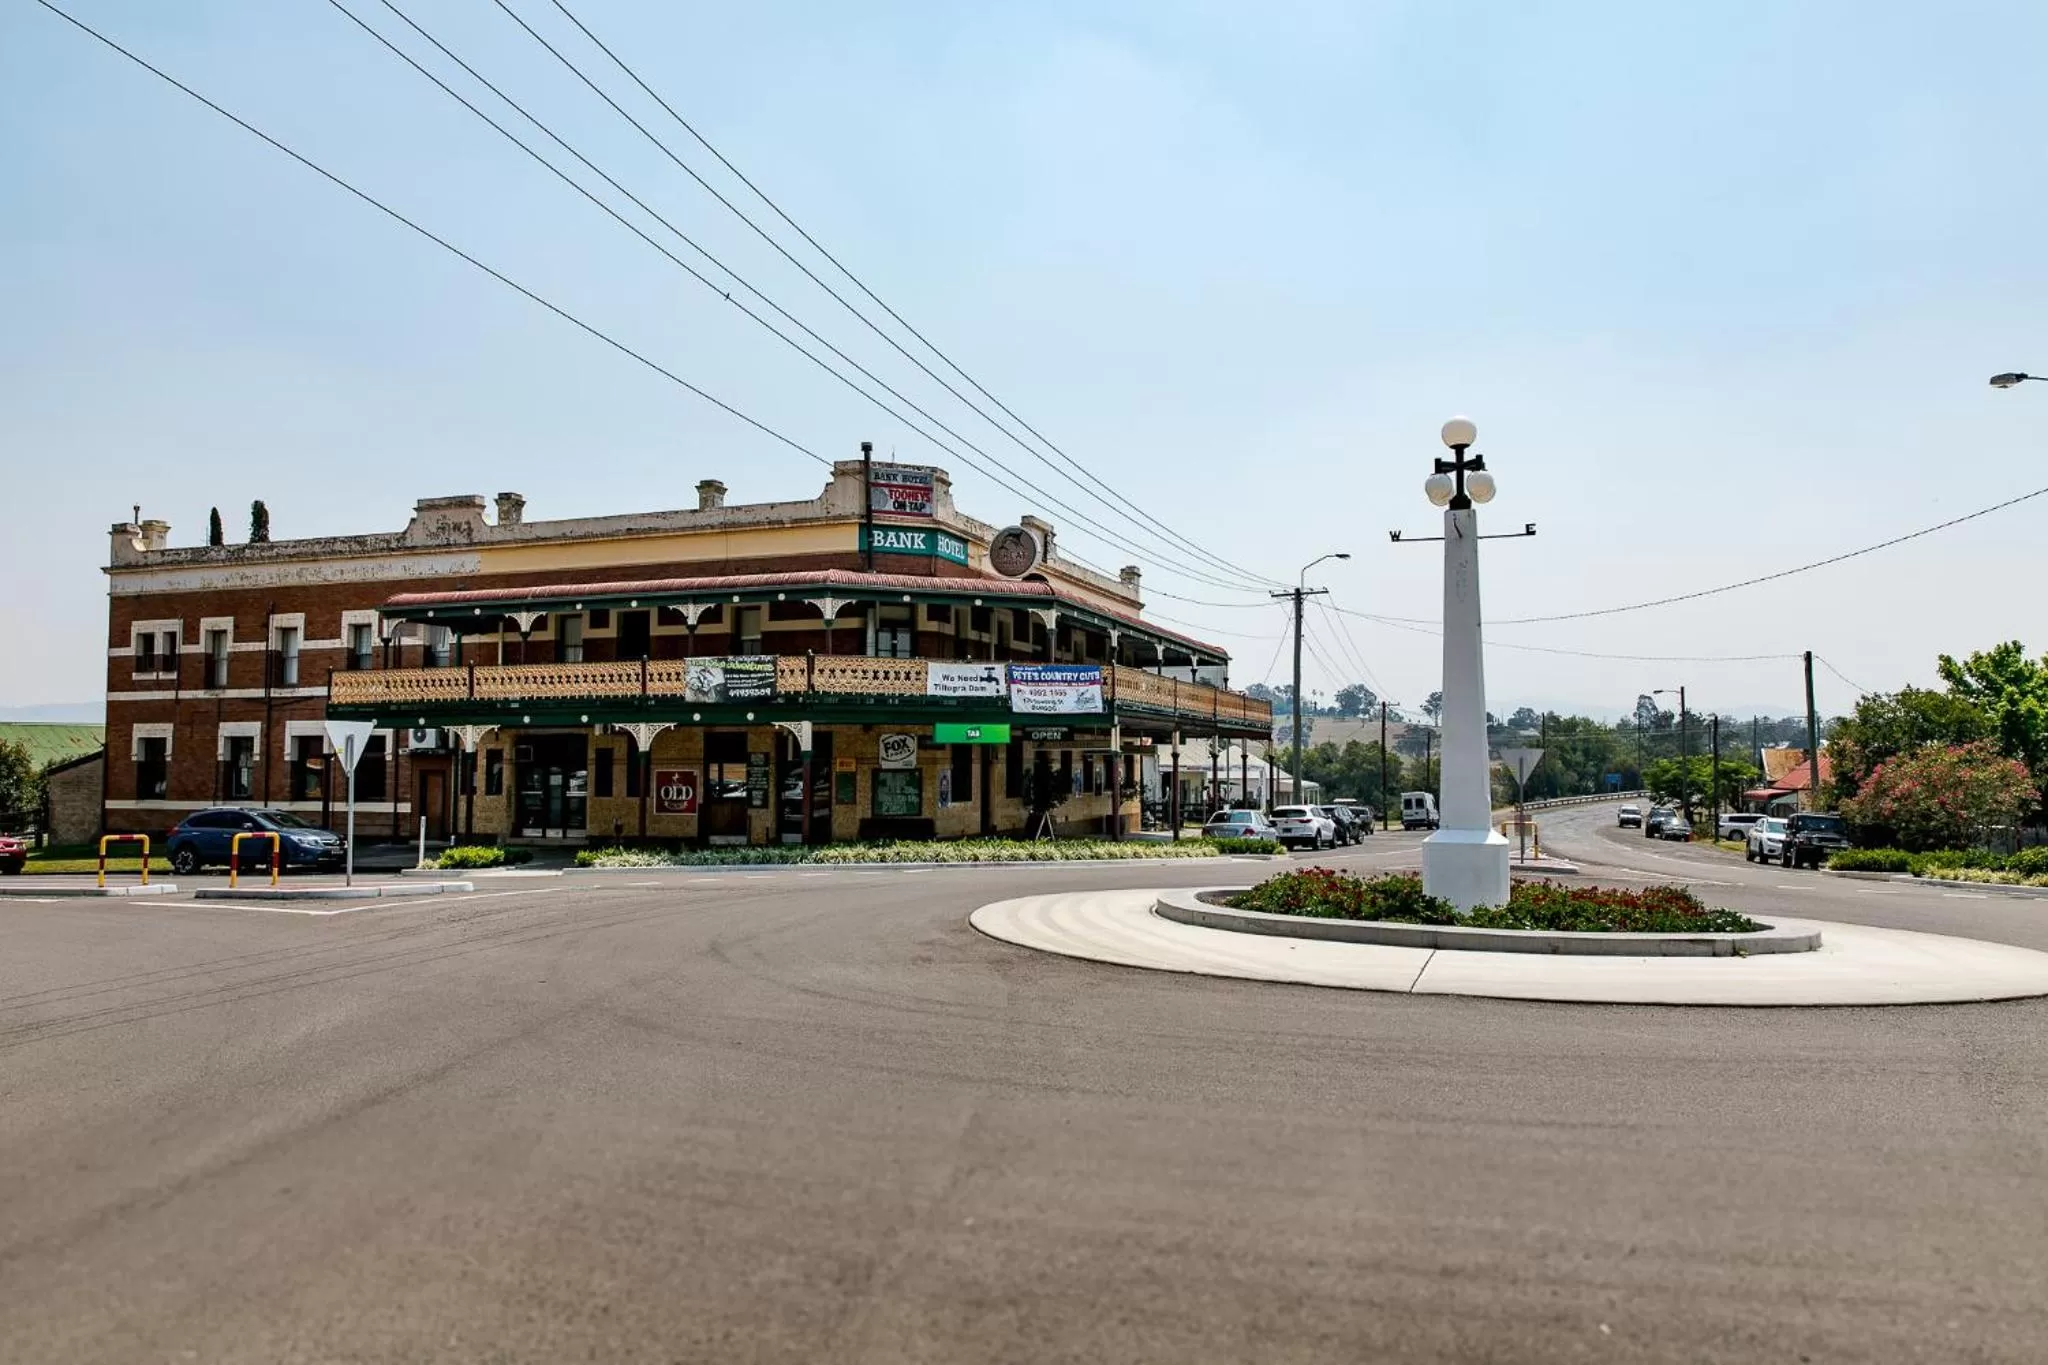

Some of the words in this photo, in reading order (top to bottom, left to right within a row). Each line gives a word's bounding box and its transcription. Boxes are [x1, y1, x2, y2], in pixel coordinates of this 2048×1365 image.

[874, 471, 898, 482] BANK
[902, 474, 929, 485] HOTEL
[889, 489, 931, 502] TOOHEYS
[1389, 530, 1401, 542] W
[1525, 523, 1536, 536] E
[872, 530, 926, 550] BANK
[937, 533, 965, 560] HOTEL
[942, 674, 955, 682] We
[957, 674, 979, 682] Need
[1041, 671, 1079, 681] COUNTRY
[1080, 670, 1100, 681] CUTS
[969, 684, 987, 692] Dam
[1031, 731, 1062, 740] OPEN
[884, 737, 910, 754] FOX
[660, 785, 693, 801] OLD
